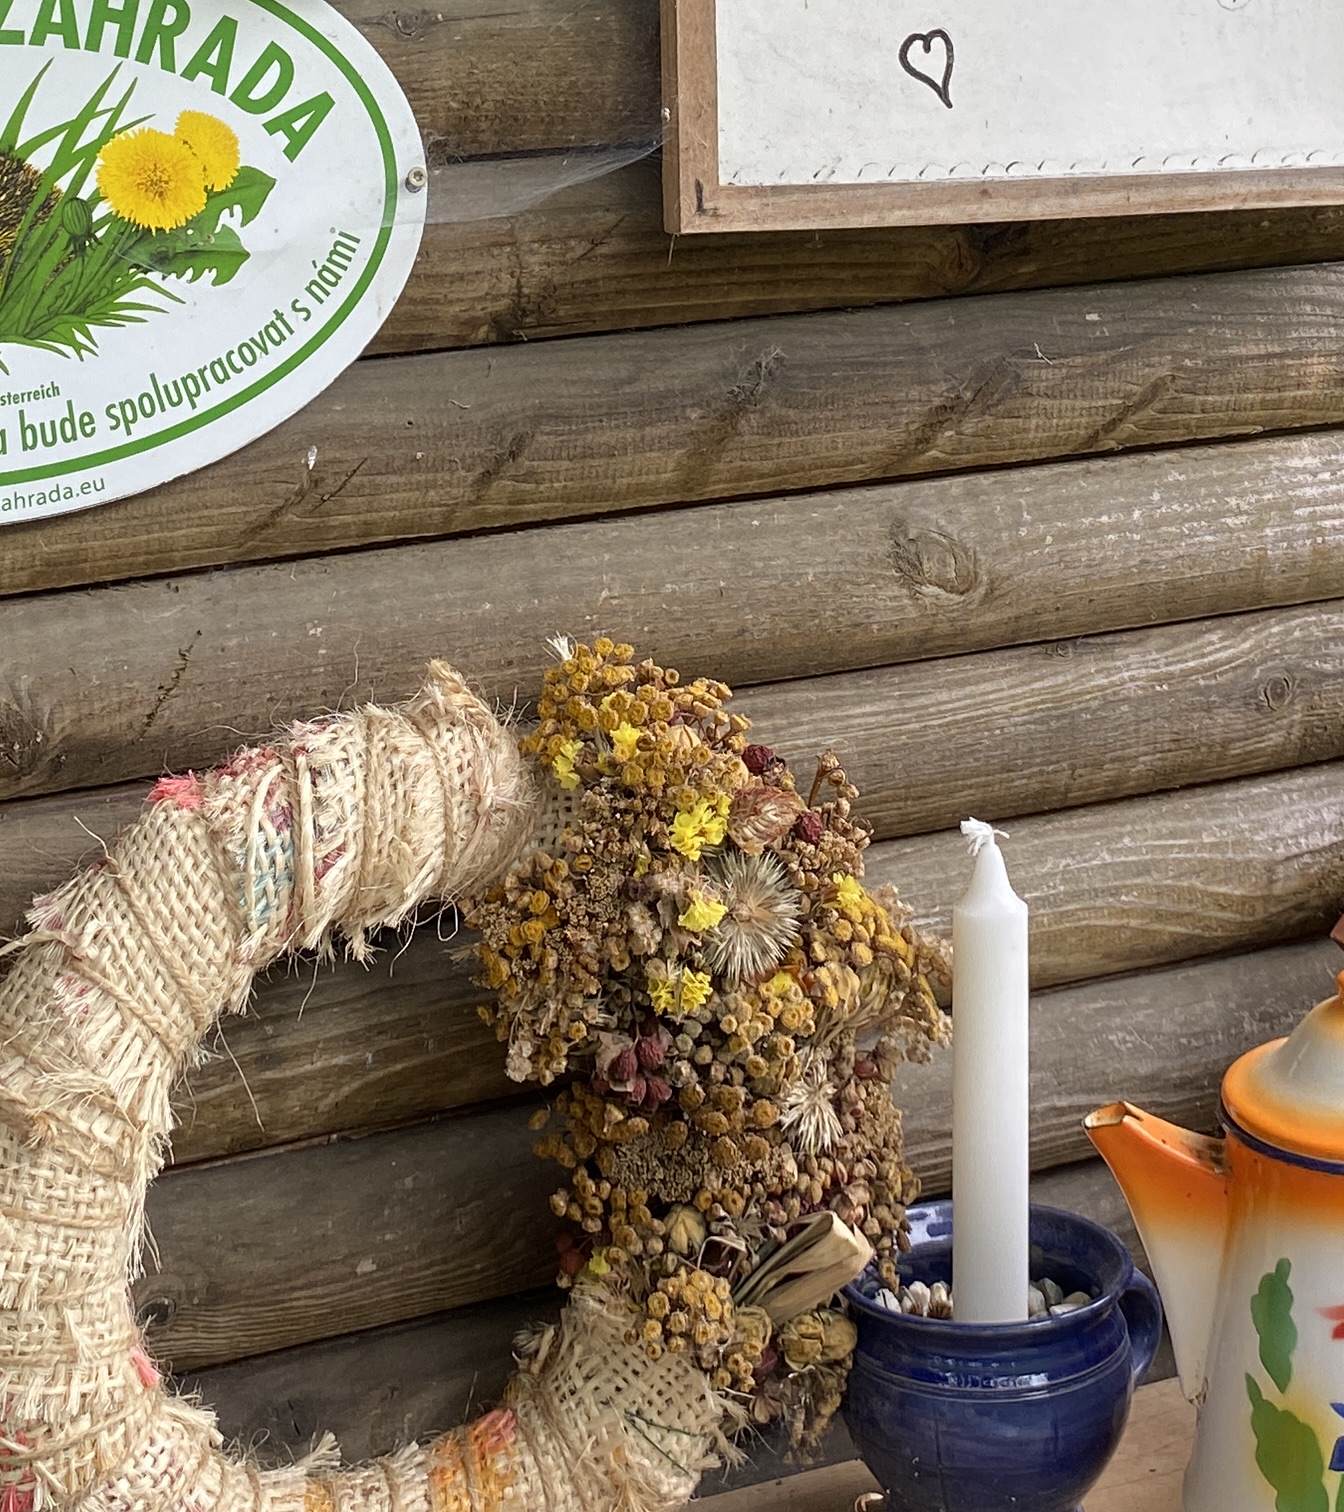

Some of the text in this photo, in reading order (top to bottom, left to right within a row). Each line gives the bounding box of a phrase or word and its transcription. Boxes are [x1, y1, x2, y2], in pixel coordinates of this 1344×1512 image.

[18, 399, 97, 451] bude
[105, 308, 296, 436] spolupracovat
[290, 298, 311, 322] s
[304, 230, 361, 305] námi
